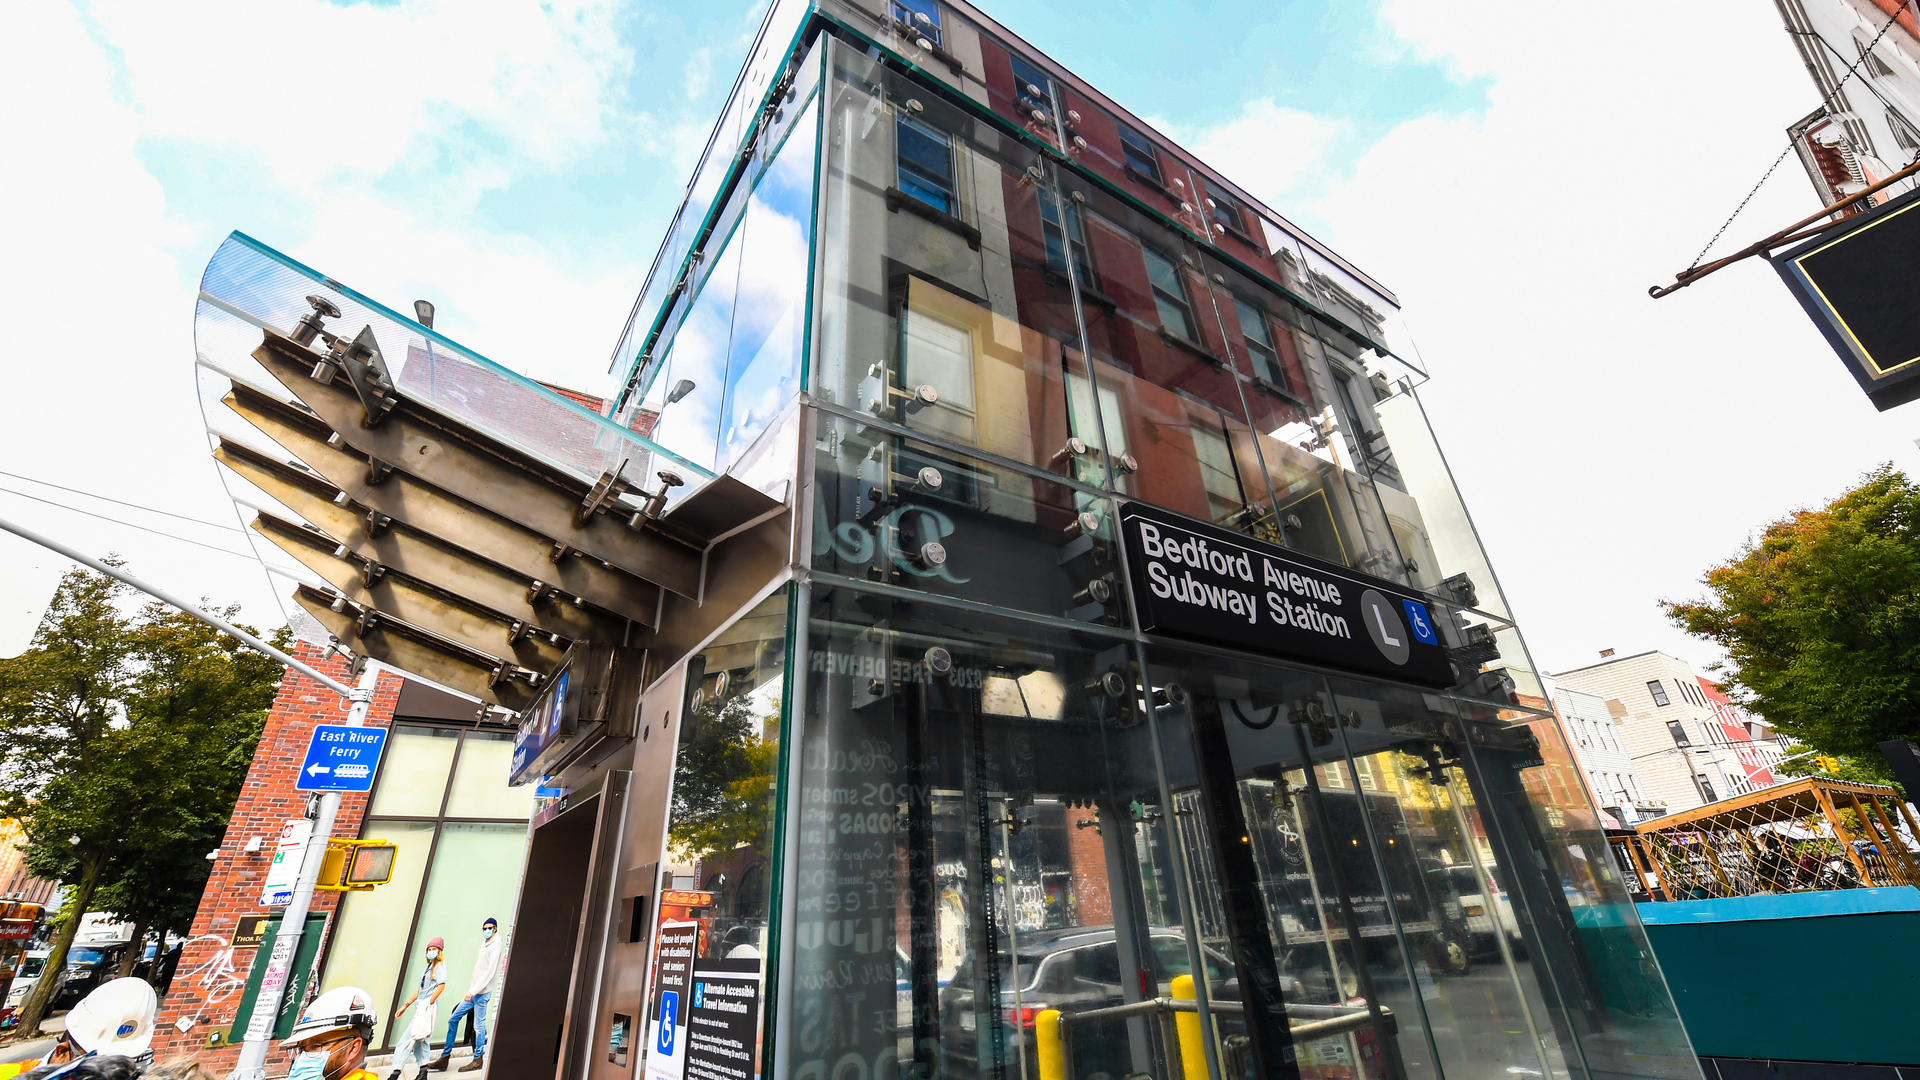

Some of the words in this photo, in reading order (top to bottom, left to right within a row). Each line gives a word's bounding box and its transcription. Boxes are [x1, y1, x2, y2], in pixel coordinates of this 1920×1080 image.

[1139, 521, 1254, 583] Bedford
[1264, 558, 1342, 606] Avenue
[1149, 562, 1256, 624] Subway
[1266, 592, 1352, 640] Station
[1372, 604, 1400, 646] L
[320, 731, 346, 742] East
[349, 733, 380, 743] River
[330, 746, 361, 759] Ferry
[661, 934, 674, 944] Please
[680, 933, 694, 946] people
[661, 947, 669, 957] with
[670, 947, 691, 957] disabilities
[663, 961, 671, 971] and
[671, 961, 685, 971] seniors
[662, 974, 674, 985] board
[674, 974, 684, 986] first.
[704, 982, 725, 996] Alternate
[726, 984, 755, 998] Accessible
[703, 997, 717, 1010] Travel
[718, 998, 748, 1014] Information
[117, 1024, 135, 1036] MTA
